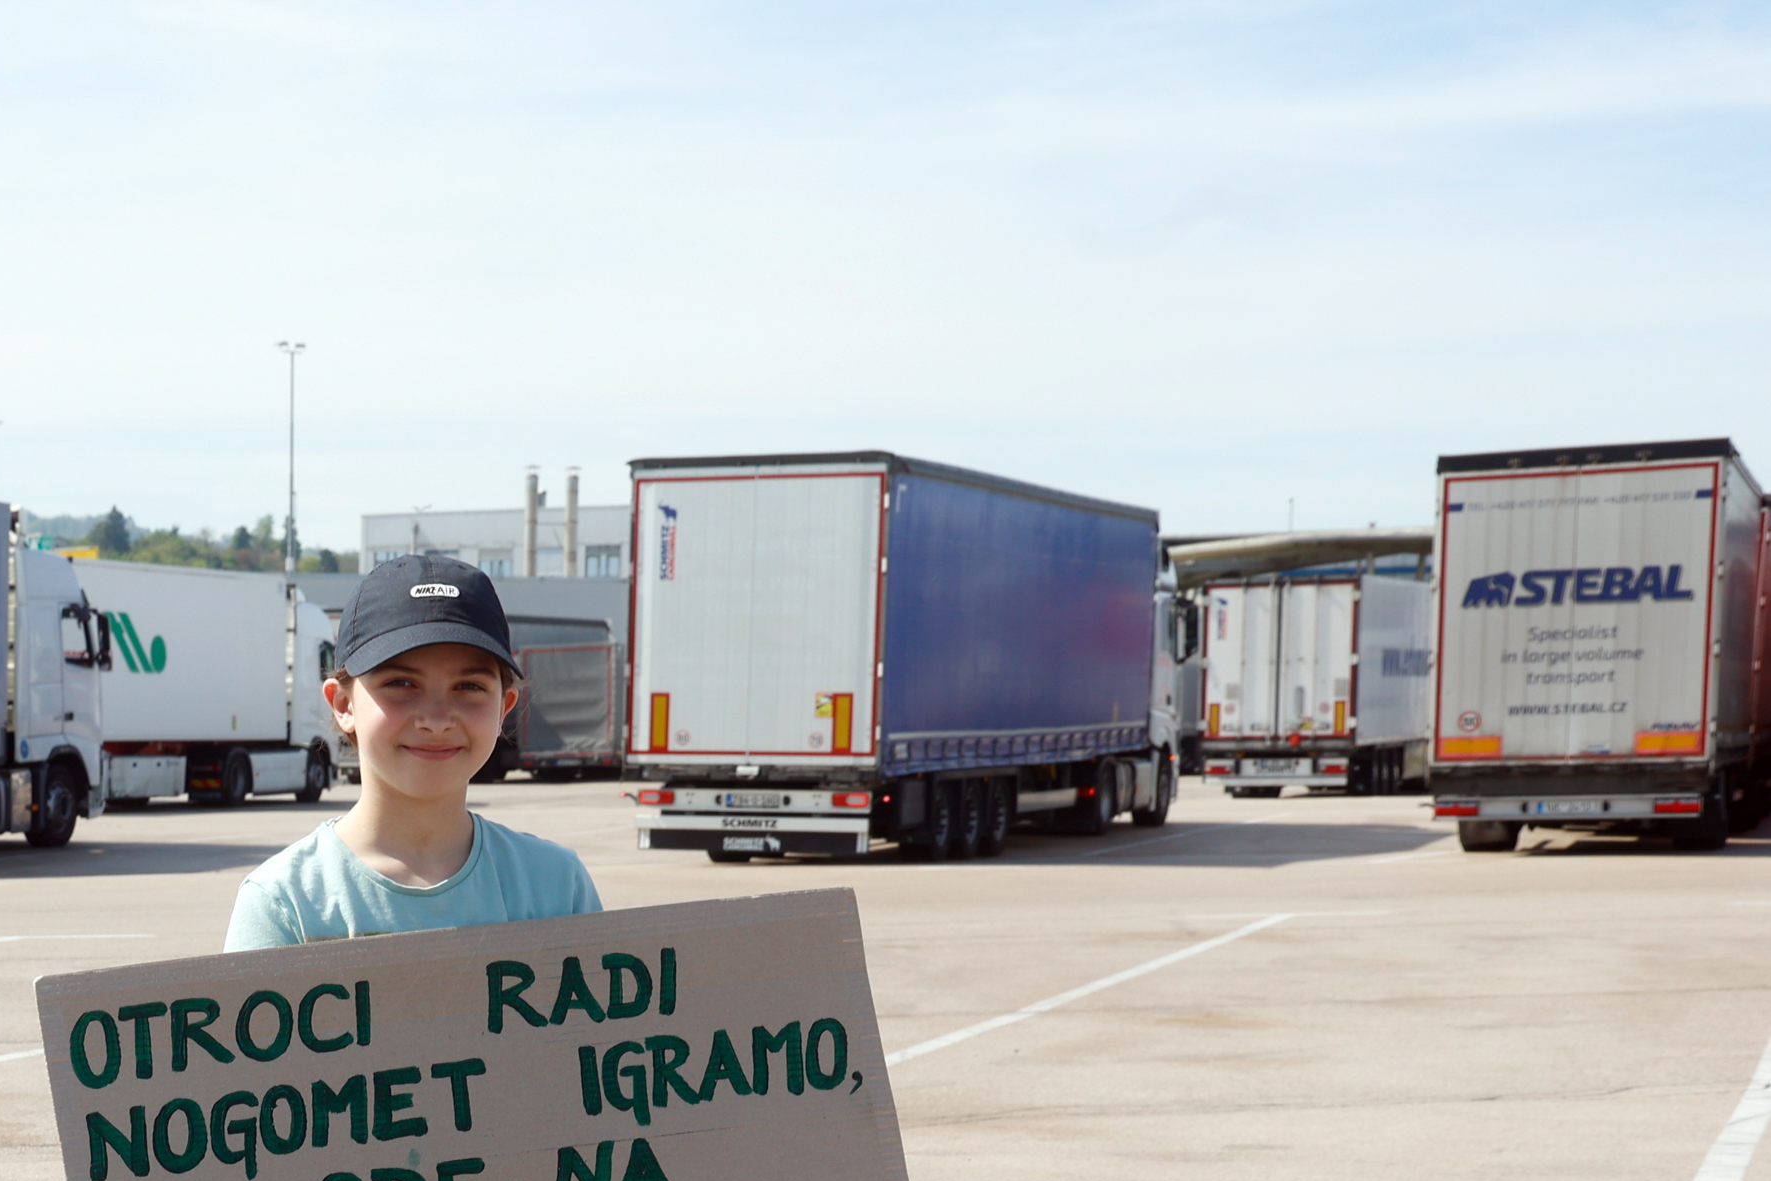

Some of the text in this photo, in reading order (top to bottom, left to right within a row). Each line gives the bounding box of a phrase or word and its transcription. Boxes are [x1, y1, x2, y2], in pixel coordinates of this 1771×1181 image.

[1514, 564, 1694, 606] STEBAL
[1527, 625, 1619, 644] Specialist
[1500, 648, 1645, 666] in large volume
[1526, 669, 1615, 688] transport
[722, 819, 777, 828] SCHMITZ
[70, 948, 677, 1089] OTROCI RADI
[86, 1018, 863, 1181] NOGOMET IGRAMO,
